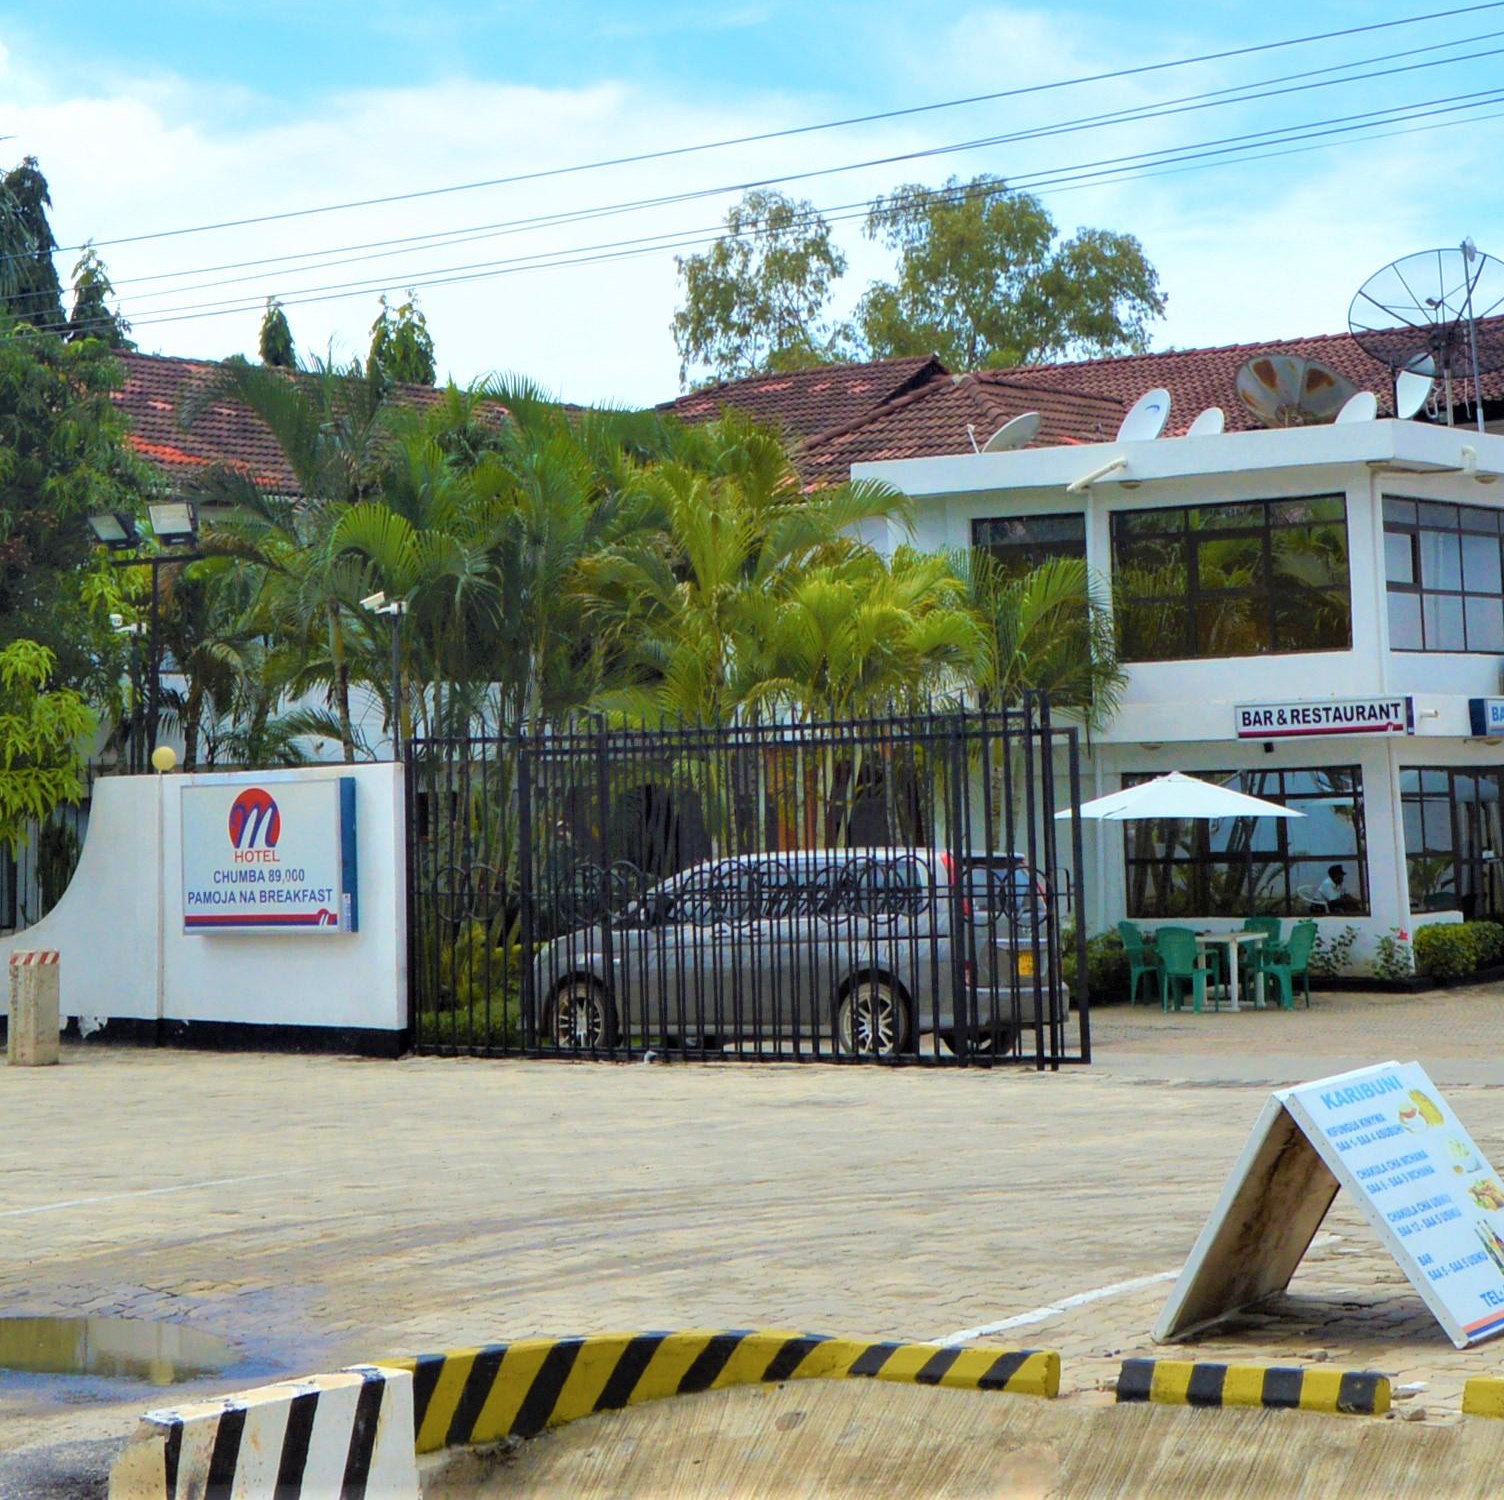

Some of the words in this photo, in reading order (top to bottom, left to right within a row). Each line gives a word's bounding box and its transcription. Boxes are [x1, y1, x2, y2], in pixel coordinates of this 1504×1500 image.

[1242, 711, 1273, 726] BAR
[1277, 709, 1287, 725] &
[1291, 703, 1400, 724] RESTAURANT
[235, 850, 280, 863] HOTEL
[213, 869, 265, 884] CHUMBA
[268, 869, 305, 885] 89,000
[188, 891, 236, 904] PAMOJA
[240, 890, 256, 903] NA
[259, 889, 333, 903] BREAKFAST
[1321, 1075, 1404, 1110] KARIBUNI
[1417, 1253, 1433, 1265] BAR
[1427, 1268, 1443, 1279] SAA
[1449, 1260, 1464, 1271] SAA
